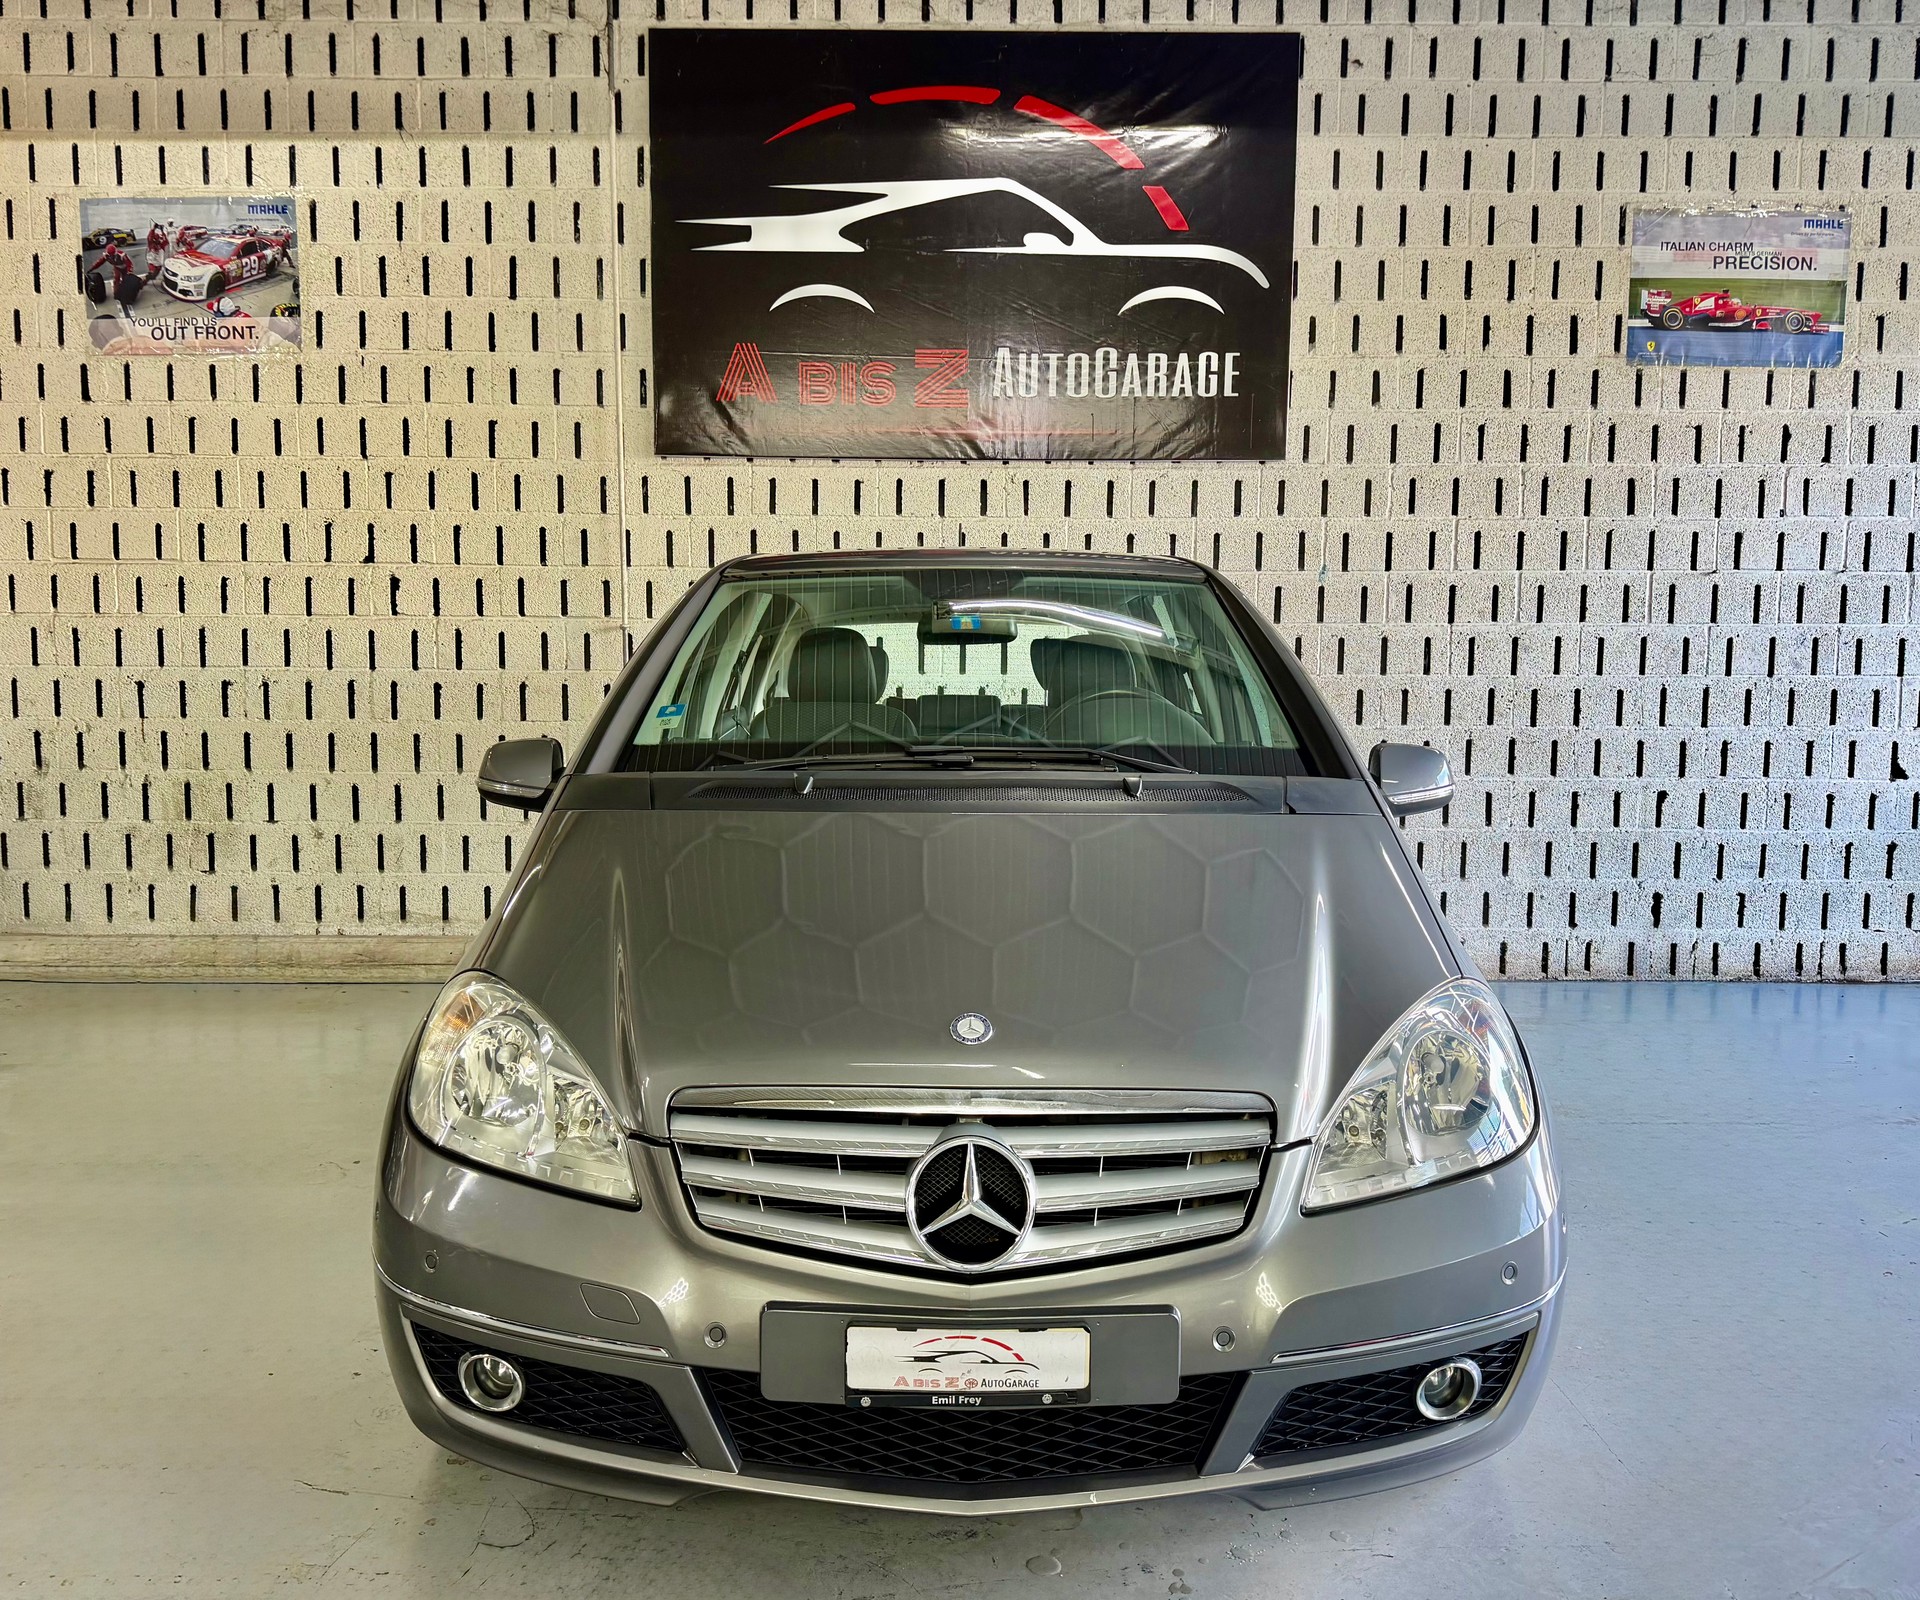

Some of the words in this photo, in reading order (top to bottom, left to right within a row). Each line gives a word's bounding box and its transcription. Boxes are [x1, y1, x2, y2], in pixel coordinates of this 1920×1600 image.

[247, 204, 288, 215] MAHLE
[1803, 219, 1844, 229] MAHLE
[1660, 241, 1706, 252] ITALIAN
[1708, 241, 1754, 252] CHARM
[241, 255, 259, 278] 29
[1713, 255, 1818, 271] PRECISION.
[131, 317, 171, 327] YOU'LL
[174, 317, 199, 327] FIND
[202, 317, 217, 327] US
[151, 326, 189, 341] OUT
[194, 325, 259, 340] FRONT.
[716, 343, 777, 404] A
[798, 361, 897, 406] BIS
[914, 348, 969, 408] Z
[893, 1375, 910, 1387] A
[945, 1376, 960, 1388] Z
[931, 1395, 956, 1405] Emil
[959, 1396, 982, 1406] Frey
